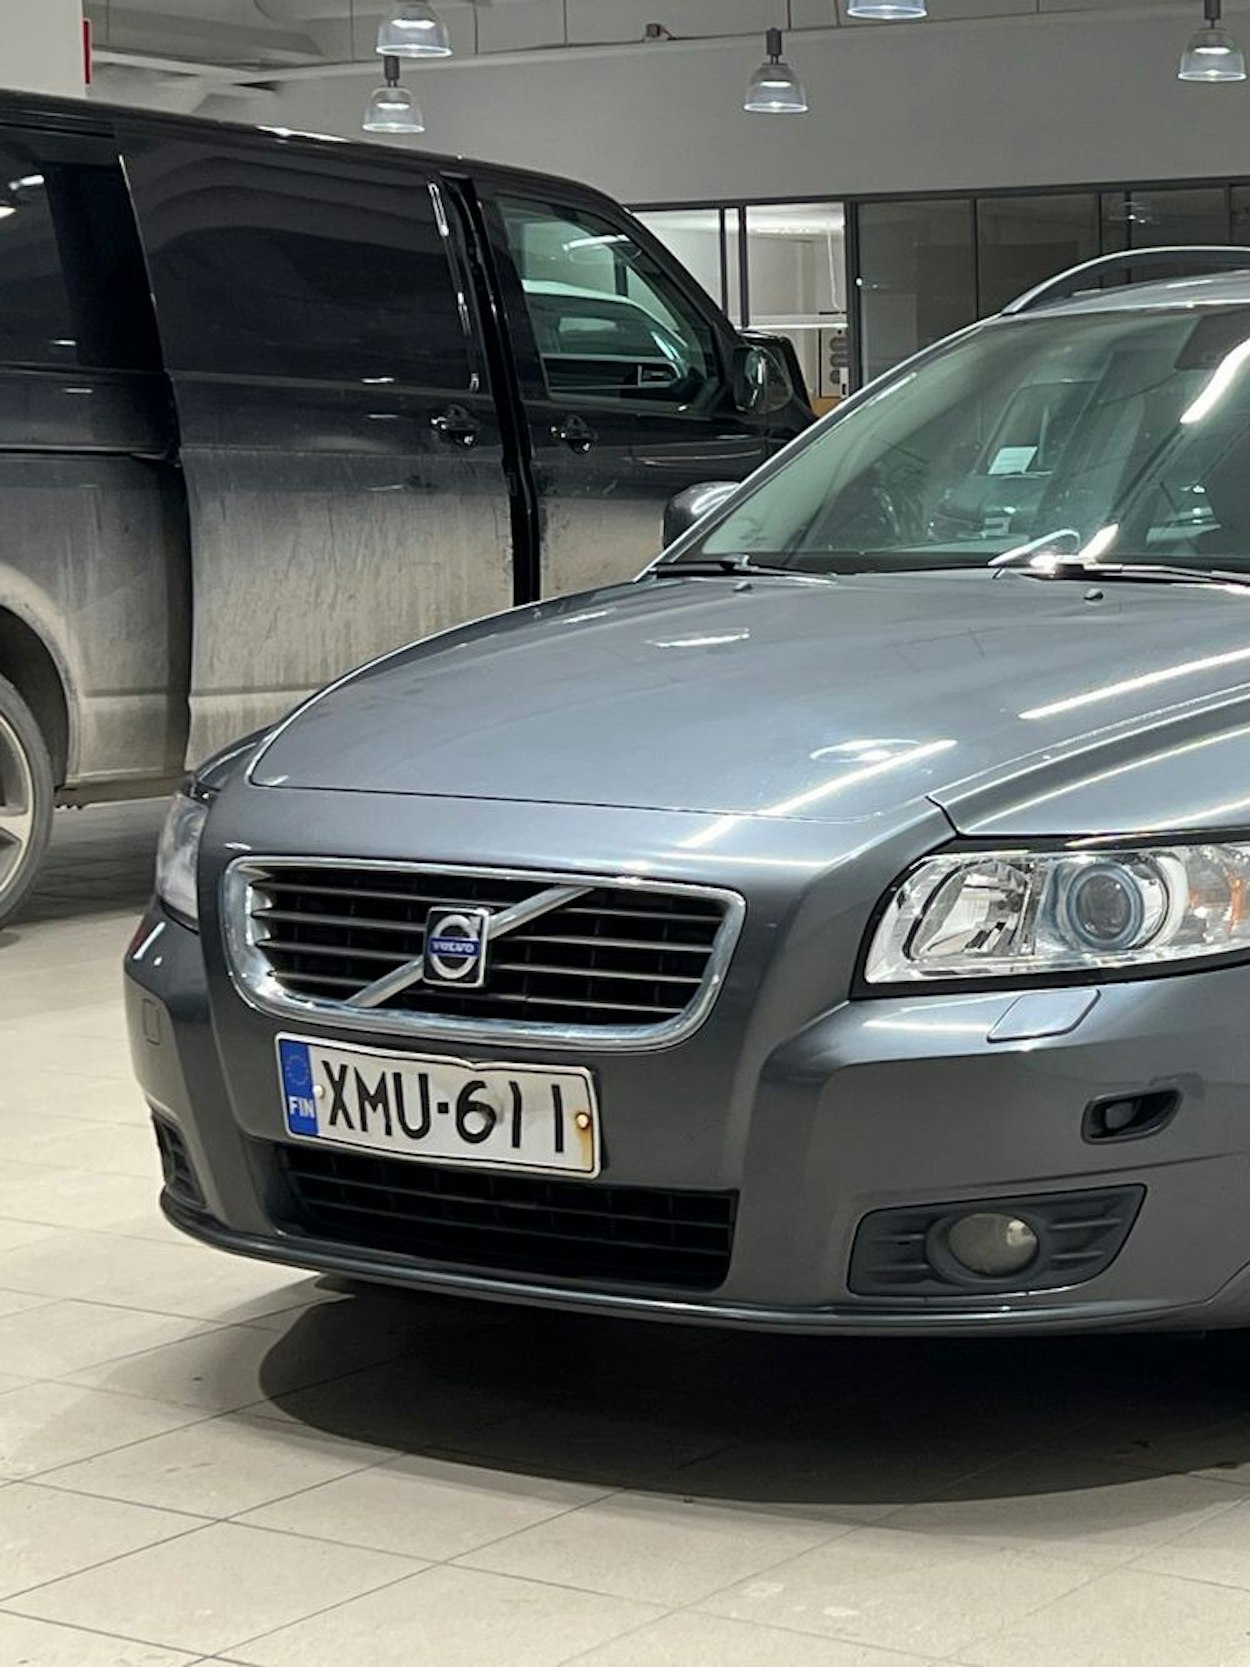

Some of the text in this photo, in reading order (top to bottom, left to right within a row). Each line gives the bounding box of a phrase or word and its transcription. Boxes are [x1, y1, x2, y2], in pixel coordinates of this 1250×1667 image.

[431, 942, 475, 953] VOLVO
[289, 1096, 316, 1118] FIN
[321, 1060, 564, 1153] XMU-611
